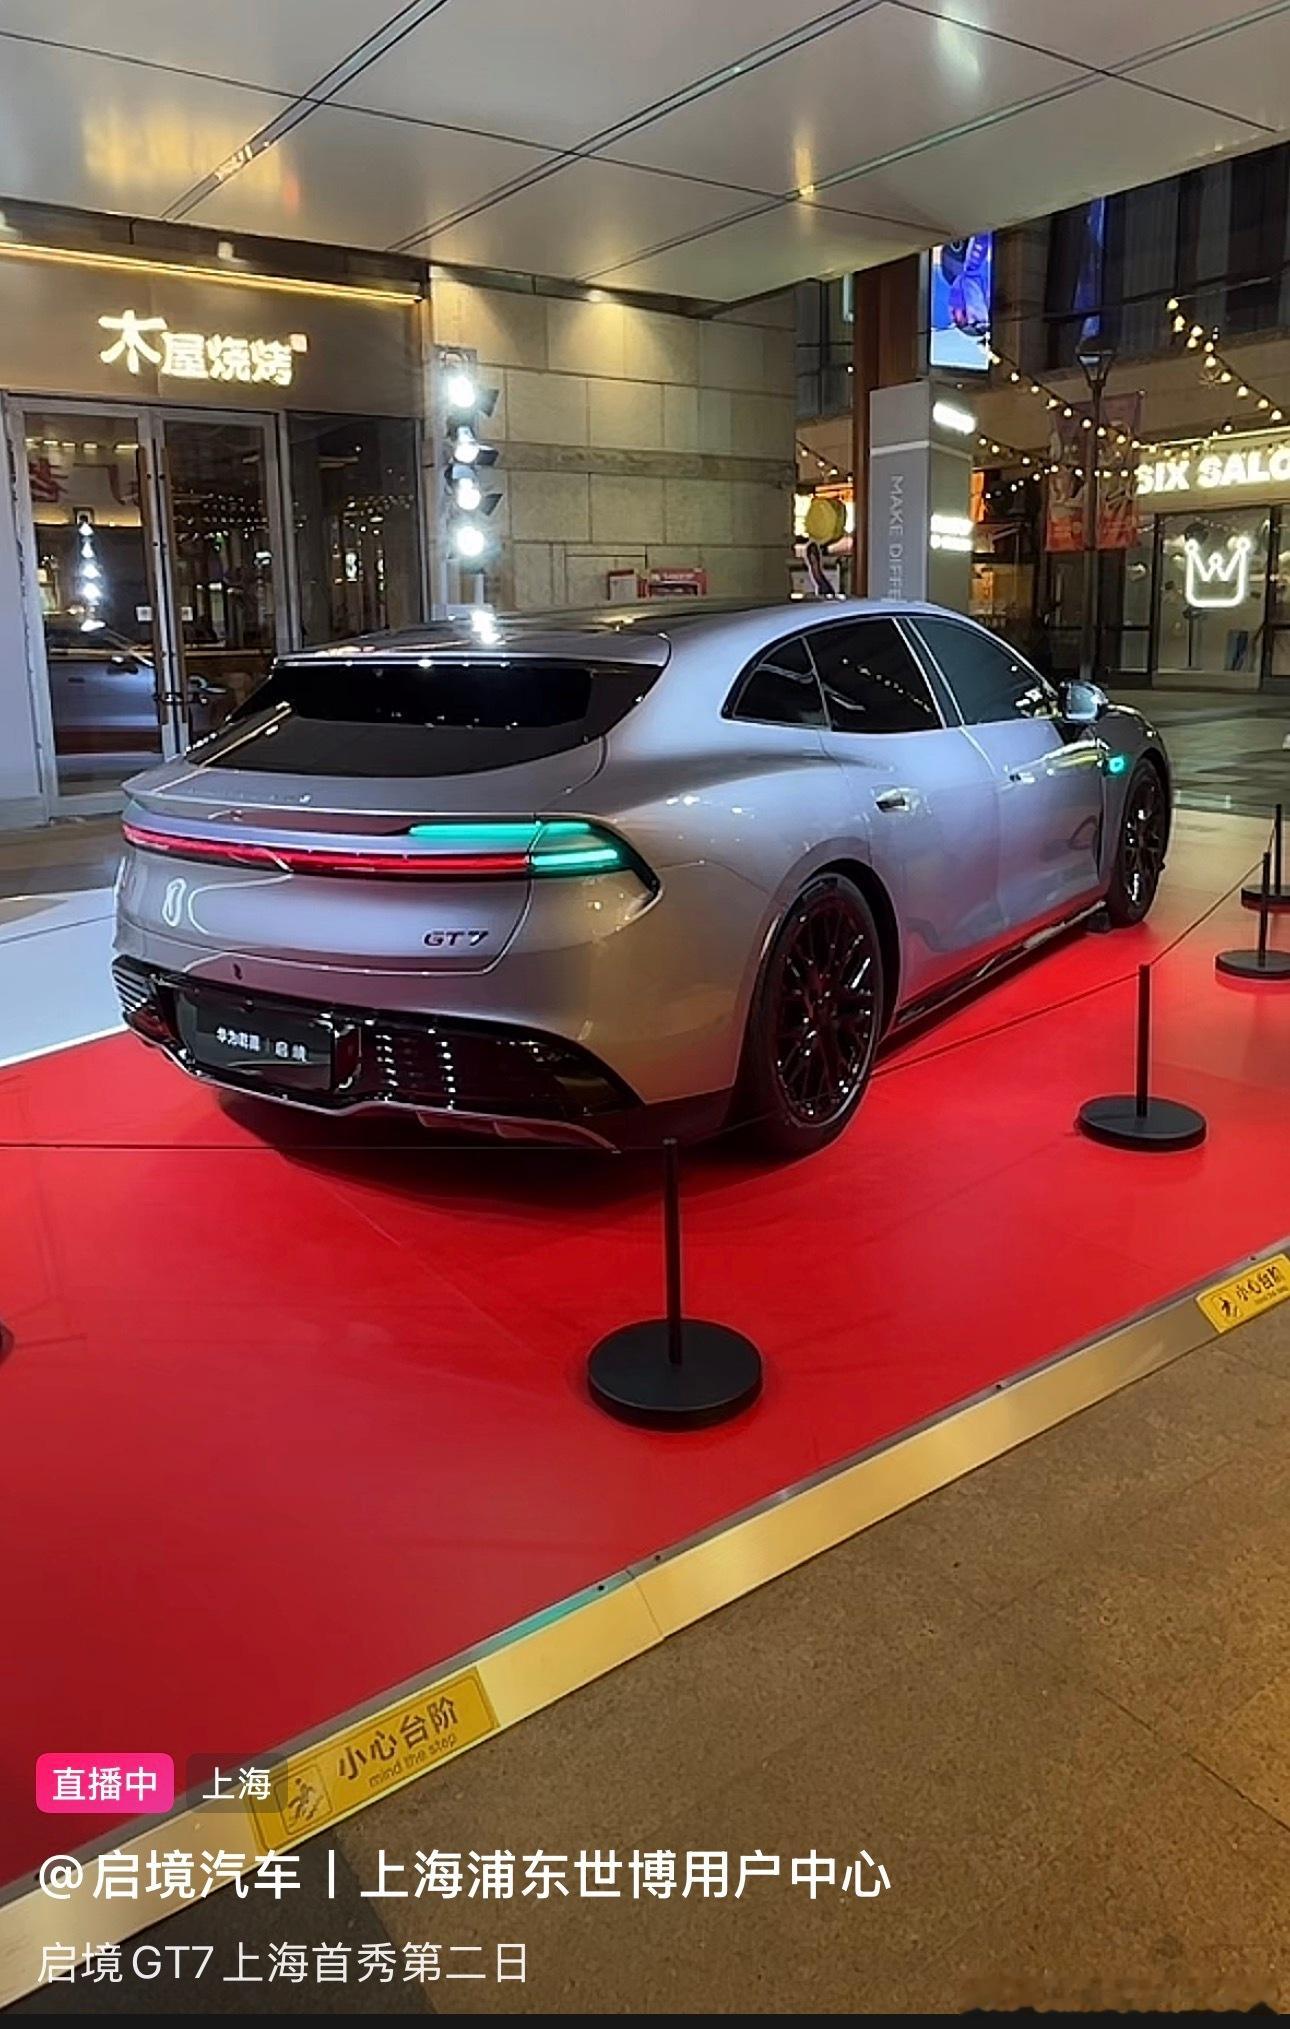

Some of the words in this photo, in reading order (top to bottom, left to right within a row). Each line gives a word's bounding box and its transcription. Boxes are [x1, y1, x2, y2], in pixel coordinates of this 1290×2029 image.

[98, 310, 293, 387] 木屋烧烤
[1134, 460, 1190, 495] SIX
[888, 474, 904, 536] MAKE
[423, 930, 489, 947] GT7
[337, 1696, 458, 1780] 小心台阶
[368, 1761, 402, 1787] mind
[404, 1751, 428, 1768] the
